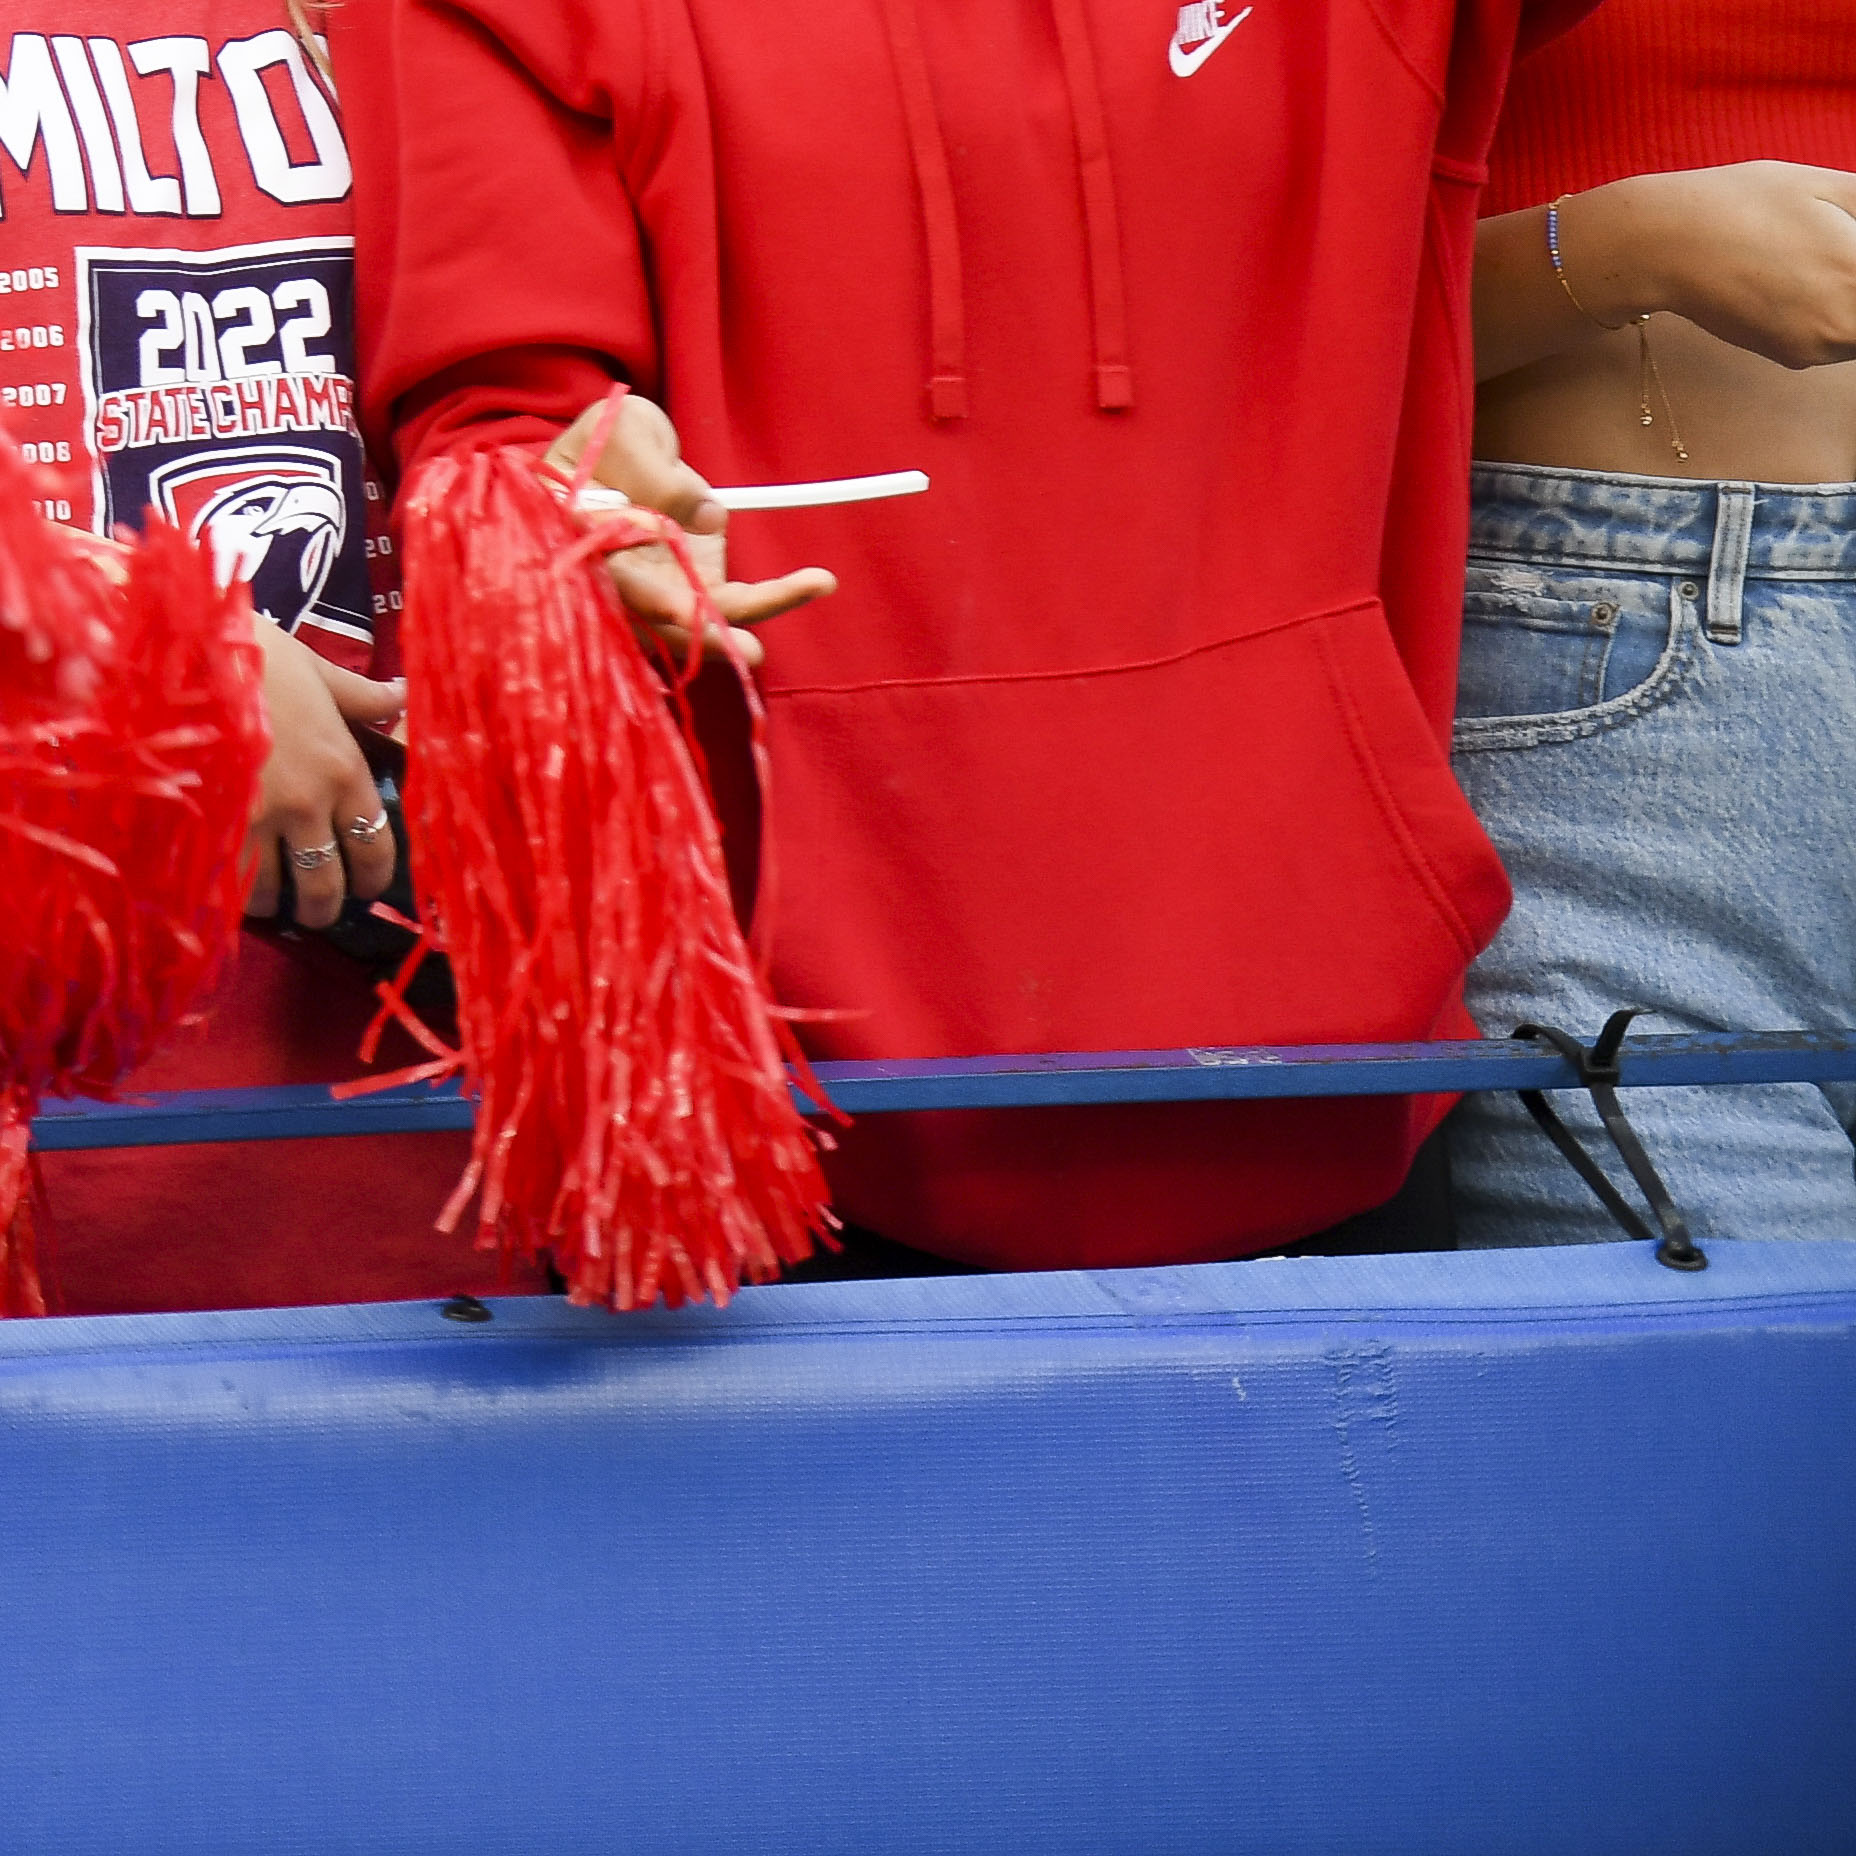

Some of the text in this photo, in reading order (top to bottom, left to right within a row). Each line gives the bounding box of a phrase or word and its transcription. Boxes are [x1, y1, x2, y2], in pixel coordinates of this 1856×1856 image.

[0, 325, 65, 352] 2006
[135, 277, 336, 387] 2022
[0, 383, 68, 408] 2007
[97, 371, 359, 453] STATE CHAMP
[21, 440, 72, 464] 008
